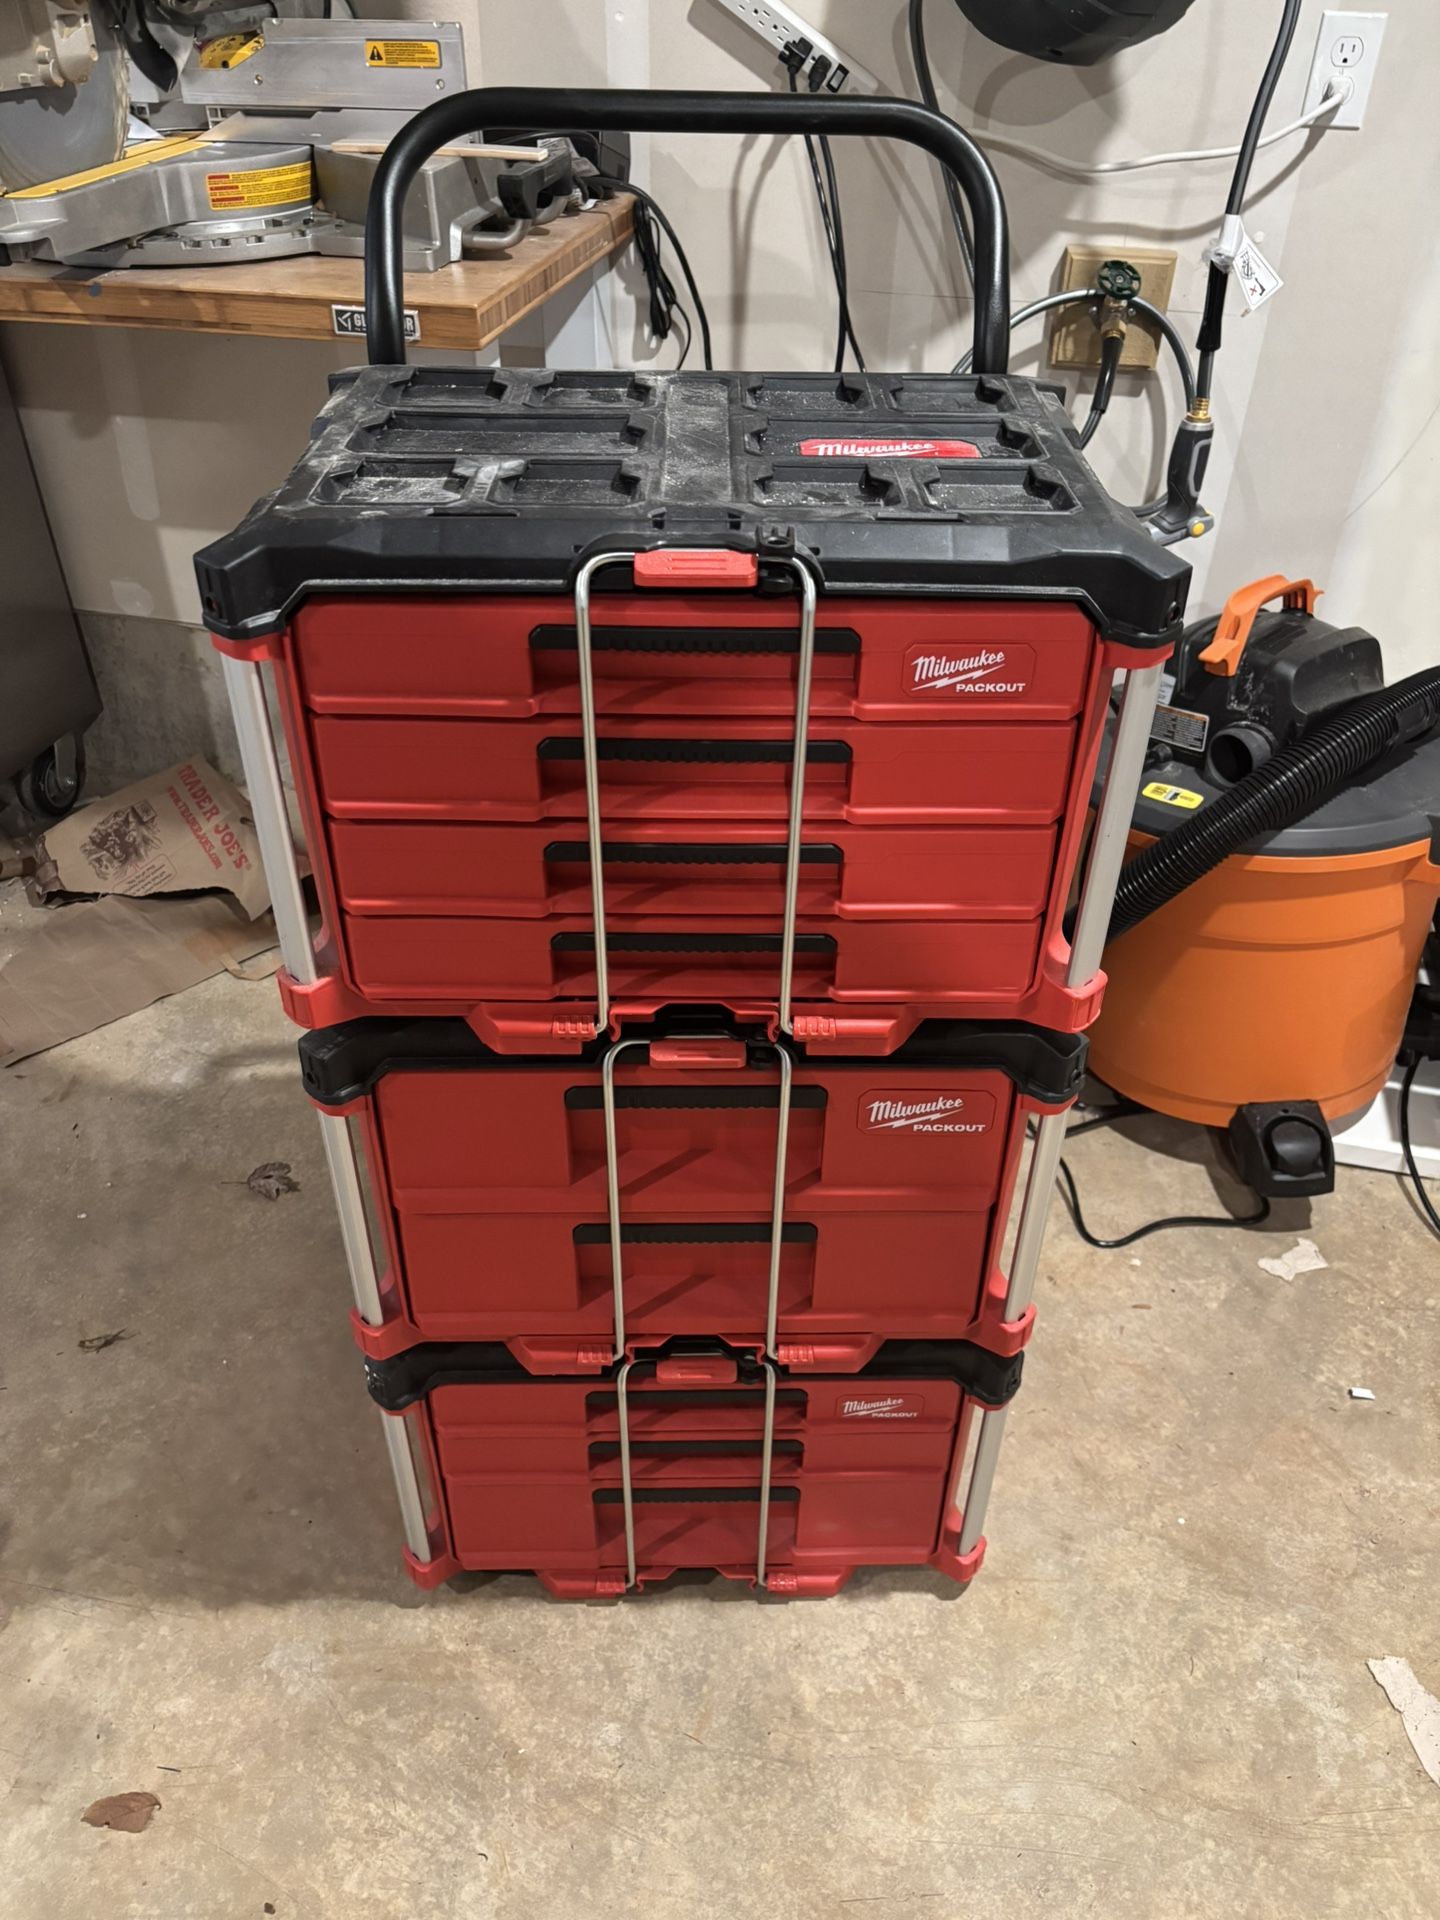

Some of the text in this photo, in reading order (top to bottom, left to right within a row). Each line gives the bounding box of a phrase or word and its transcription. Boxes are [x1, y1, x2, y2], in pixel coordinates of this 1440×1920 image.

[813, 442, 936, 457] Milwaukee
[911, 649, 1005, 682] Milwaukee
[955, 683, 1026, 692] PACKOUT
[178, 764, 248, 869] TRADER JOE'S
[865, 1097, 964, 1123] Milwaukee
[913, 1124, 986, 1132] PACKOUT
[842, 1397, 904, 1414] Milwaukee
